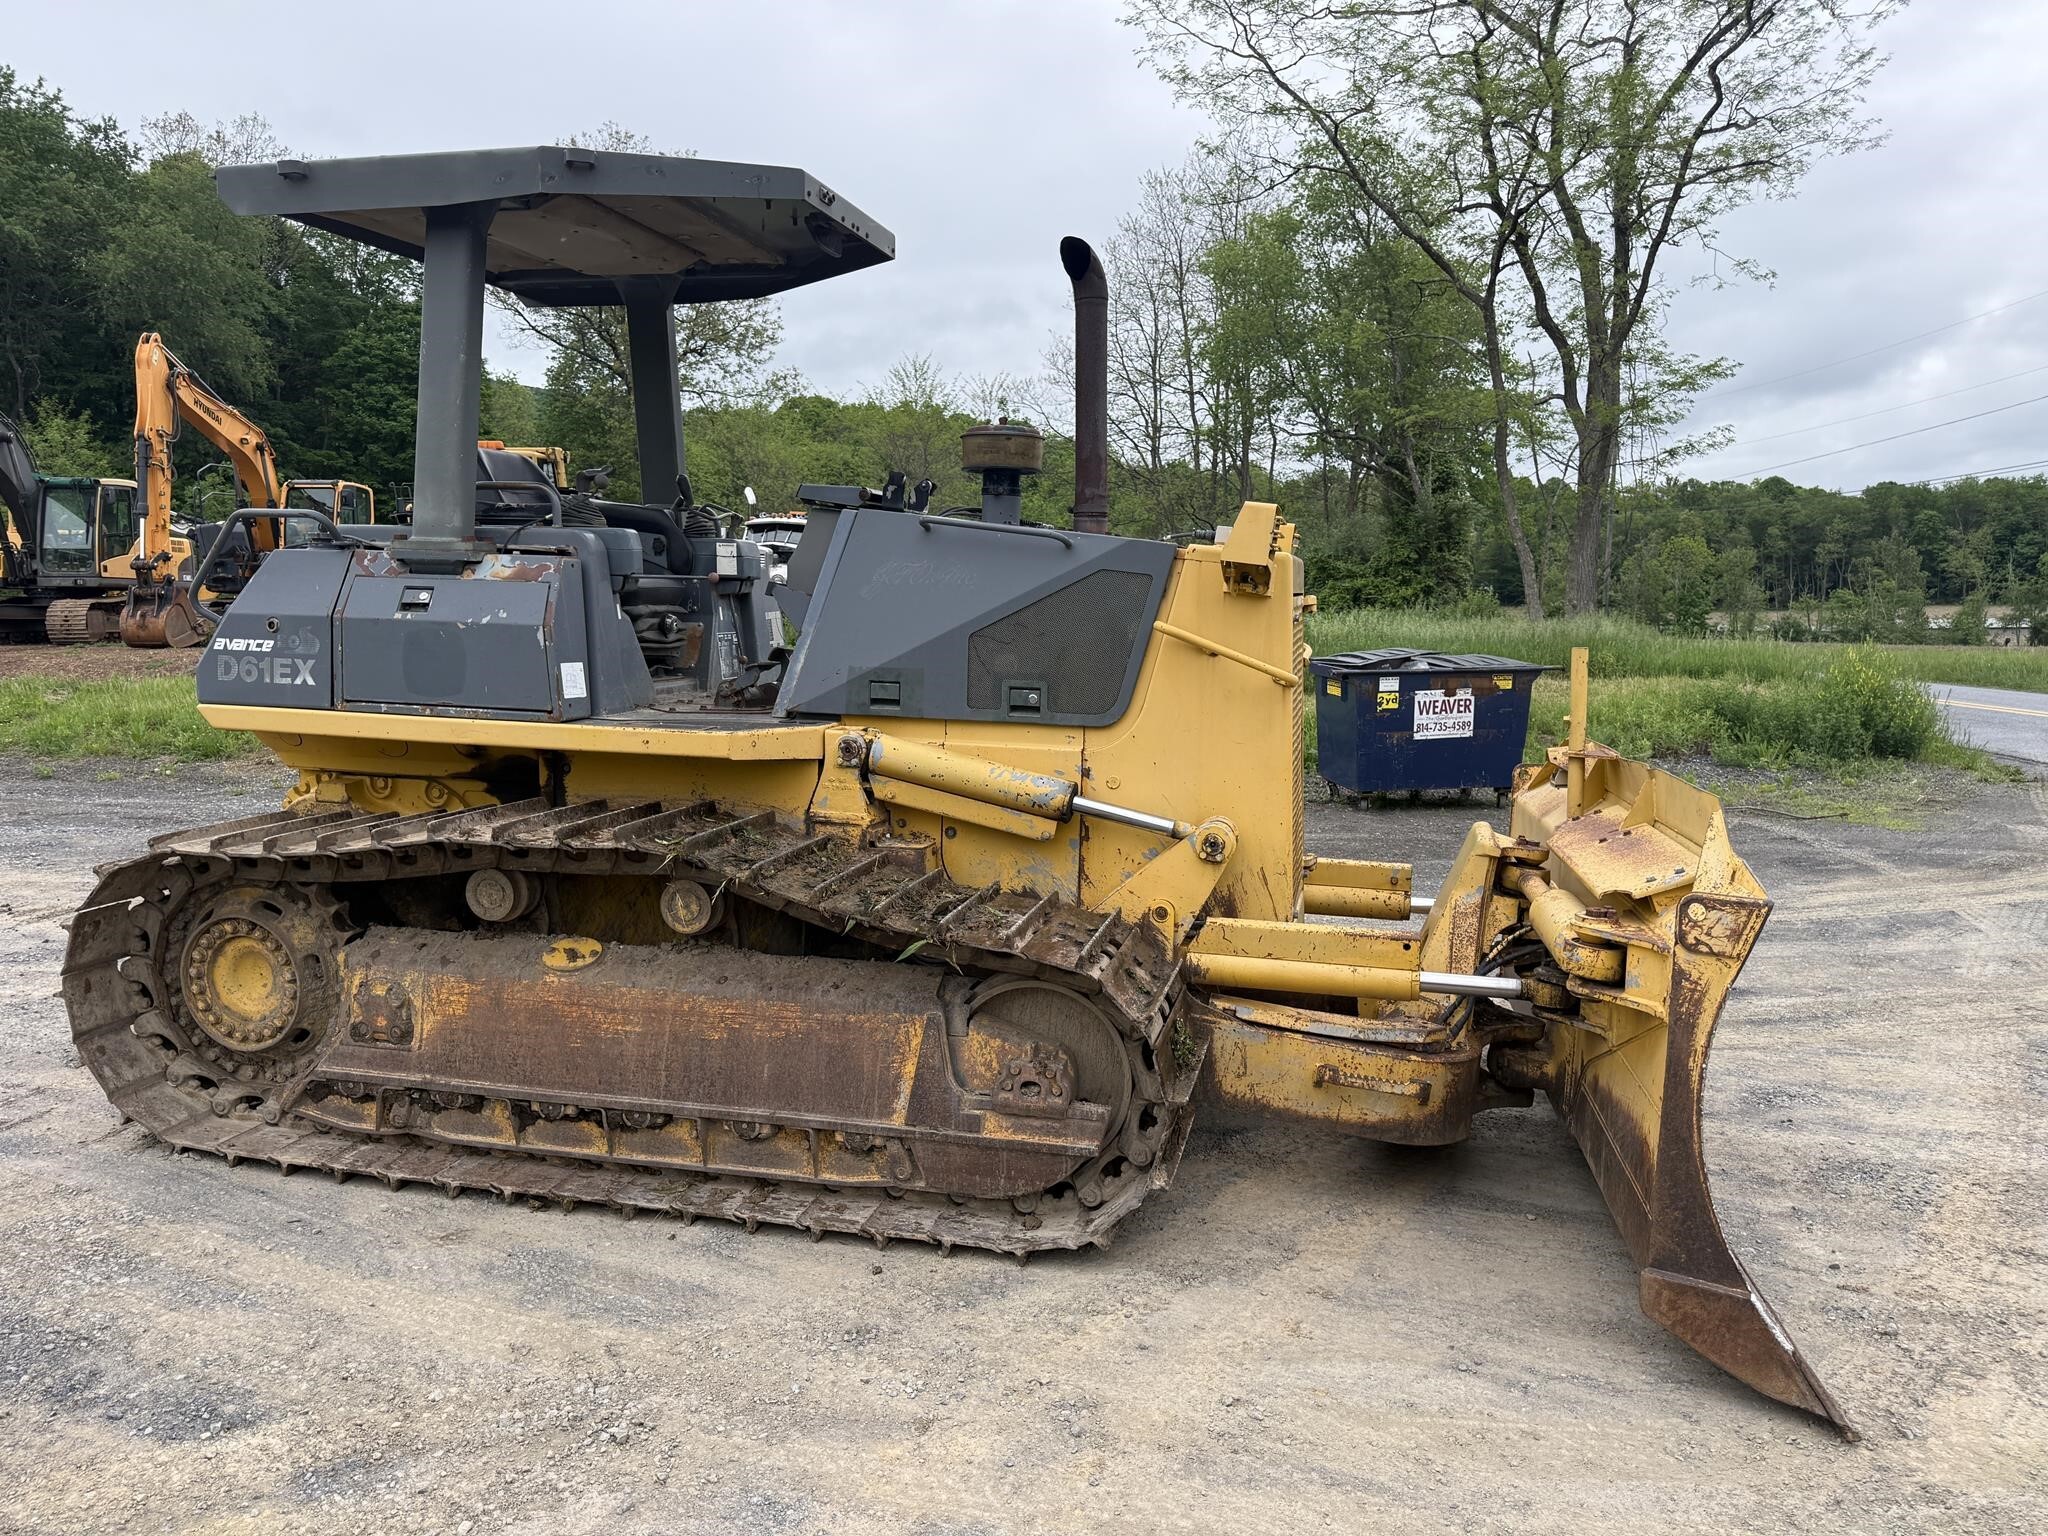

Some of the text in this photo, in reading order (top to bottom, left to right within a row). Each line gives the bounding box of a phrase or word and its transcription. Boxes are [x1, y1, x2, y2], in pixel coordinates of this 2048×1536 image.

[193, 398, 222, 426] HYUNDAI
[213, 637, 275, 652] avance
[217, 654, 316, 686] D61EX
[1417, 698, 1472, 716] WEAVER
[1416, 720, 1472, 733] 814-735-4589
